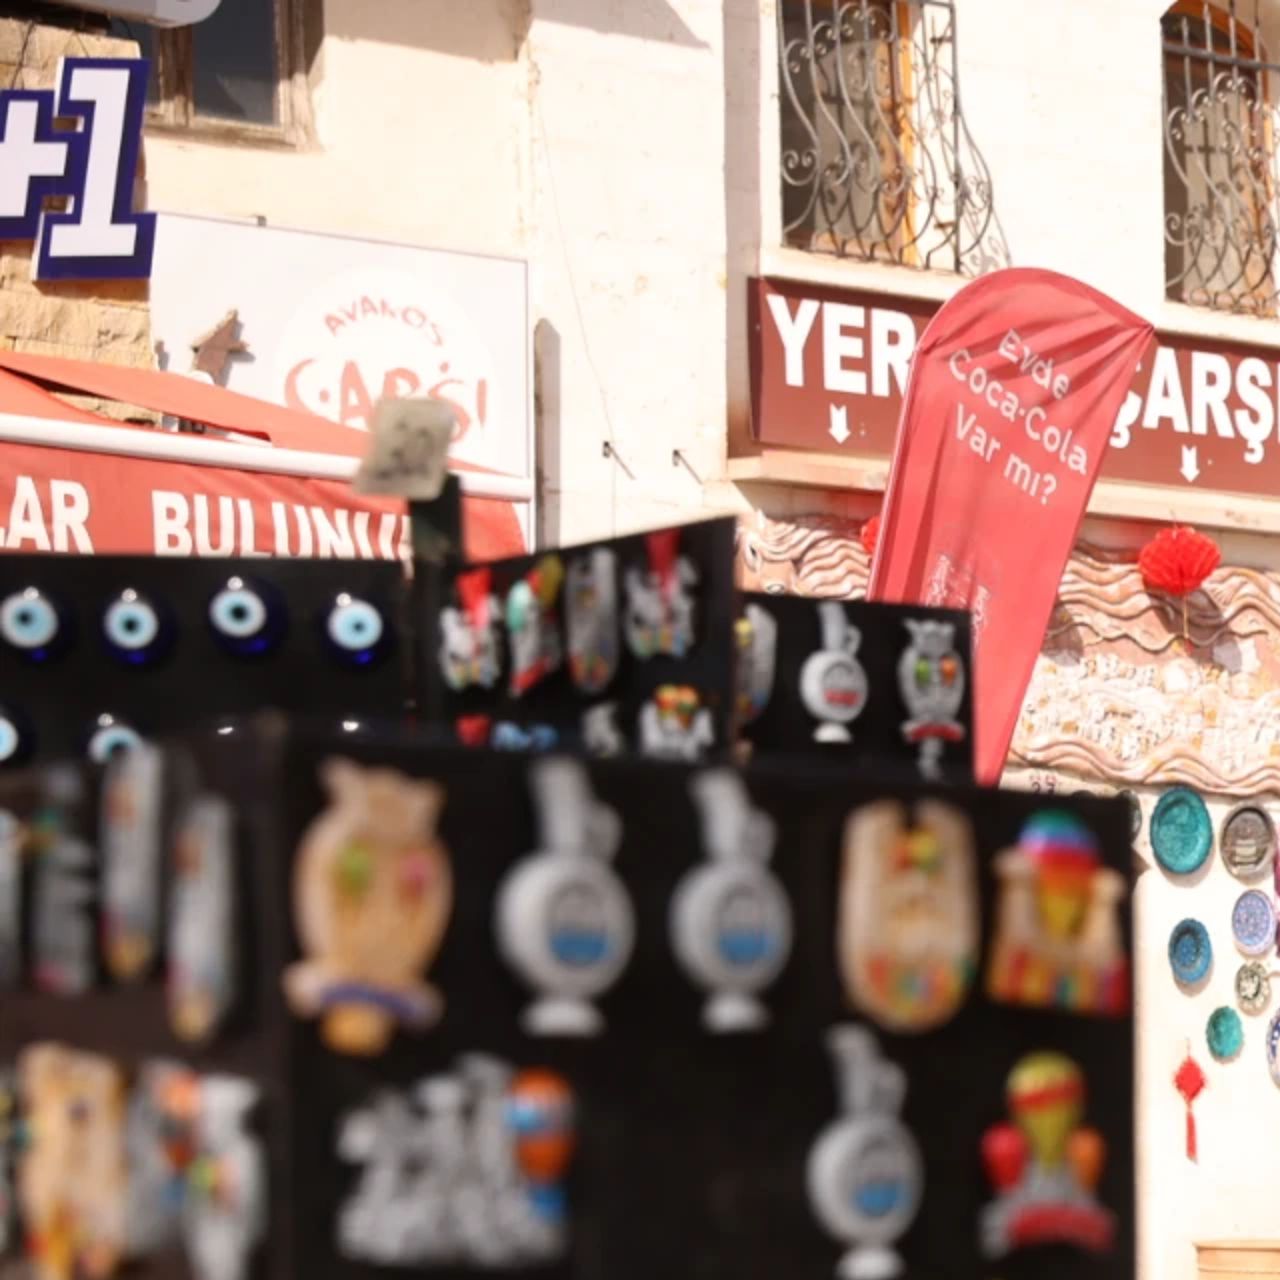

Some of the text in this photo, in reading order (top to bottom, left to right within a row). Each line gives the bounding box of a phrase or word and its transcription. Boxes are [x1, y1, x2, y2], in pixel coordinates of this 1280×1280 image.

[998, 328, 1071, 400] Evde
[956, 402, 1002, 463] Var
[0, 475, 95, 555] AR
